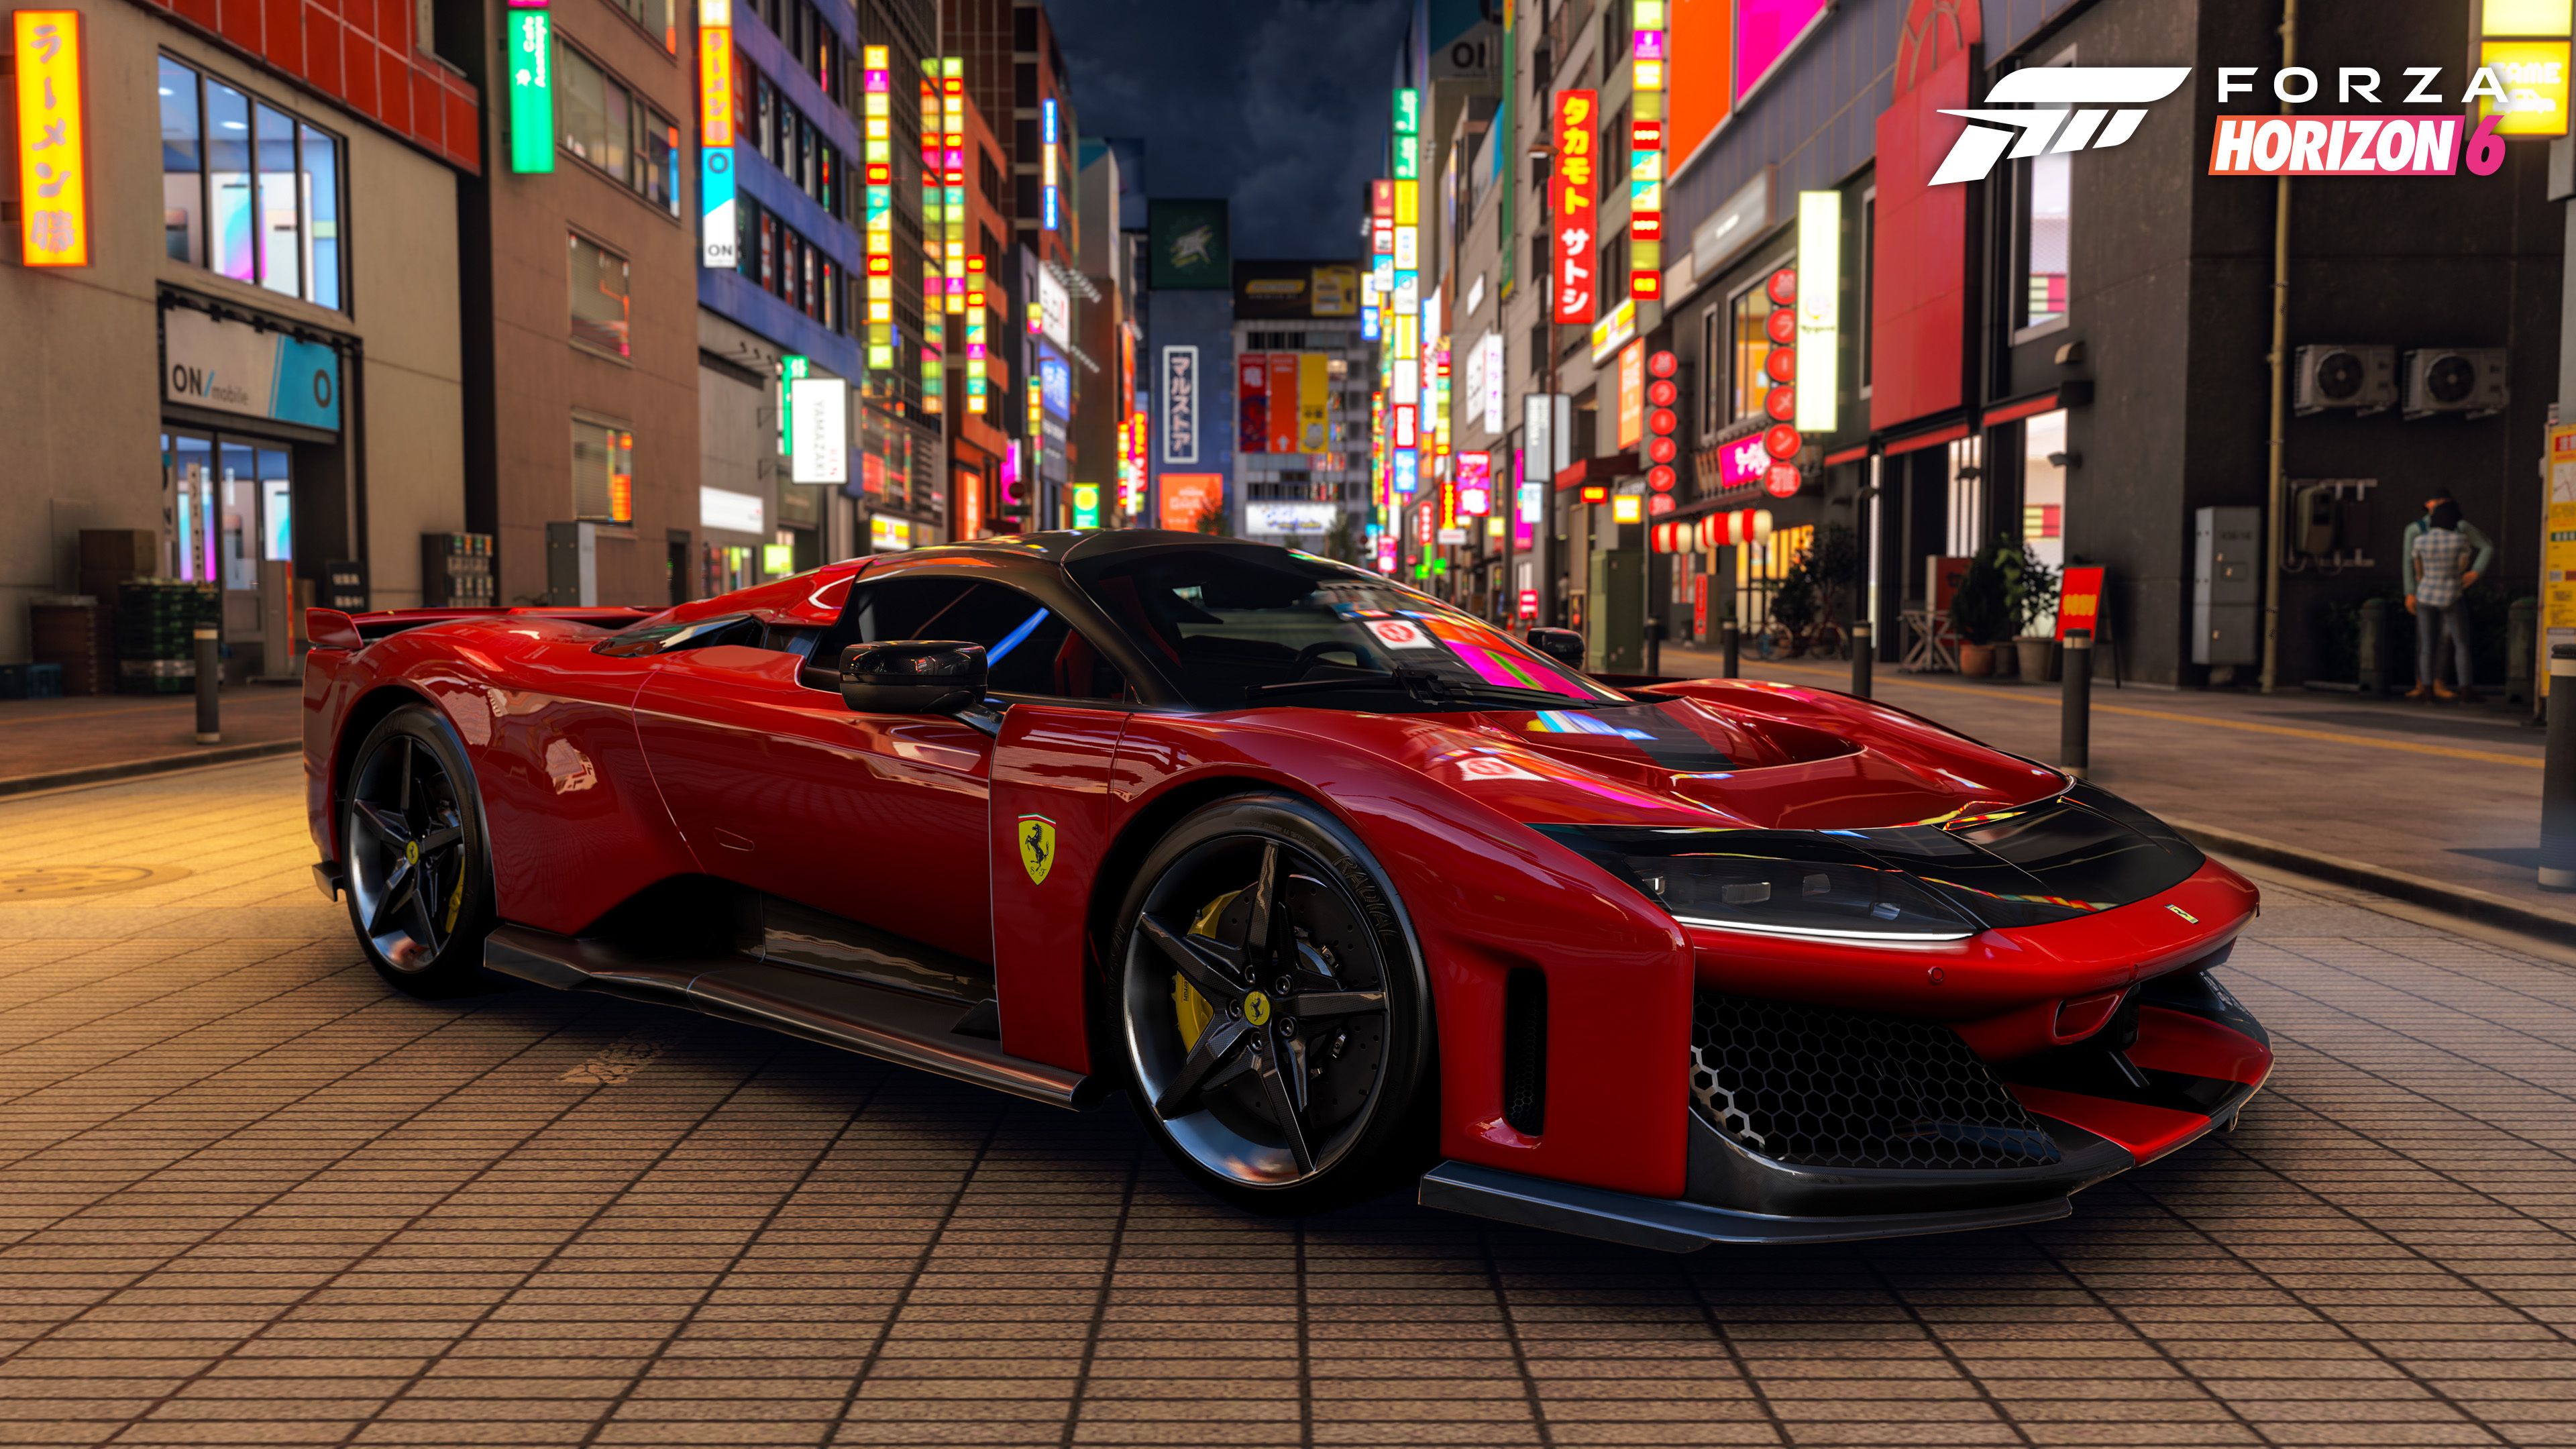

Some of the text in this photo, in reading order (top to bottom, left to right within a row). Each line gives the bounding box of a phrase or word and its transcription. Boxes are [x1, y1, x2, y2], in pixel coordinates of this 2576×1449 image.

[1562, 97, 1591, 315] タカモト サトシ
[708, 244, 733, 257] ON
[814, 399, 826, 478] YAMAZAKI
[1171, 356, 1191, 451] マルストア
[1030, 866, 1035, 875] S
[1332, 854, 1398, 946] RADIAL
